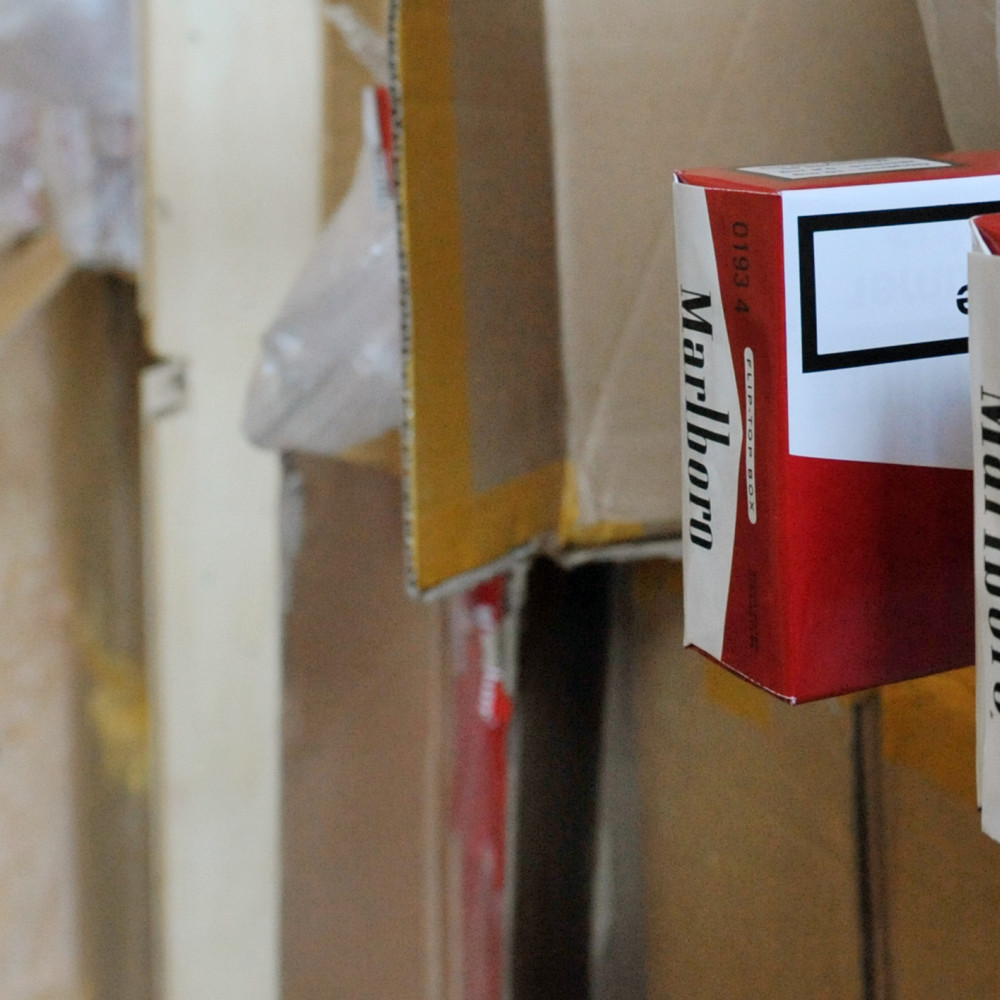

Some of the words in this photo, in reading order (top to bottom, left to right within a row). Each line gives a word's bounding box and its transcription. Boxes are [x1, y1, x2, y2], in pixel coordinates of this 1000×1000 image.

[732, 221, 749, 289] 0193
[734, 299, 750, 314] 4
[680, 285, 730, 550] Marlboro
[746, 358, 754, 458] FLIP-TOP
[747, 469, 755, 512] BOX
